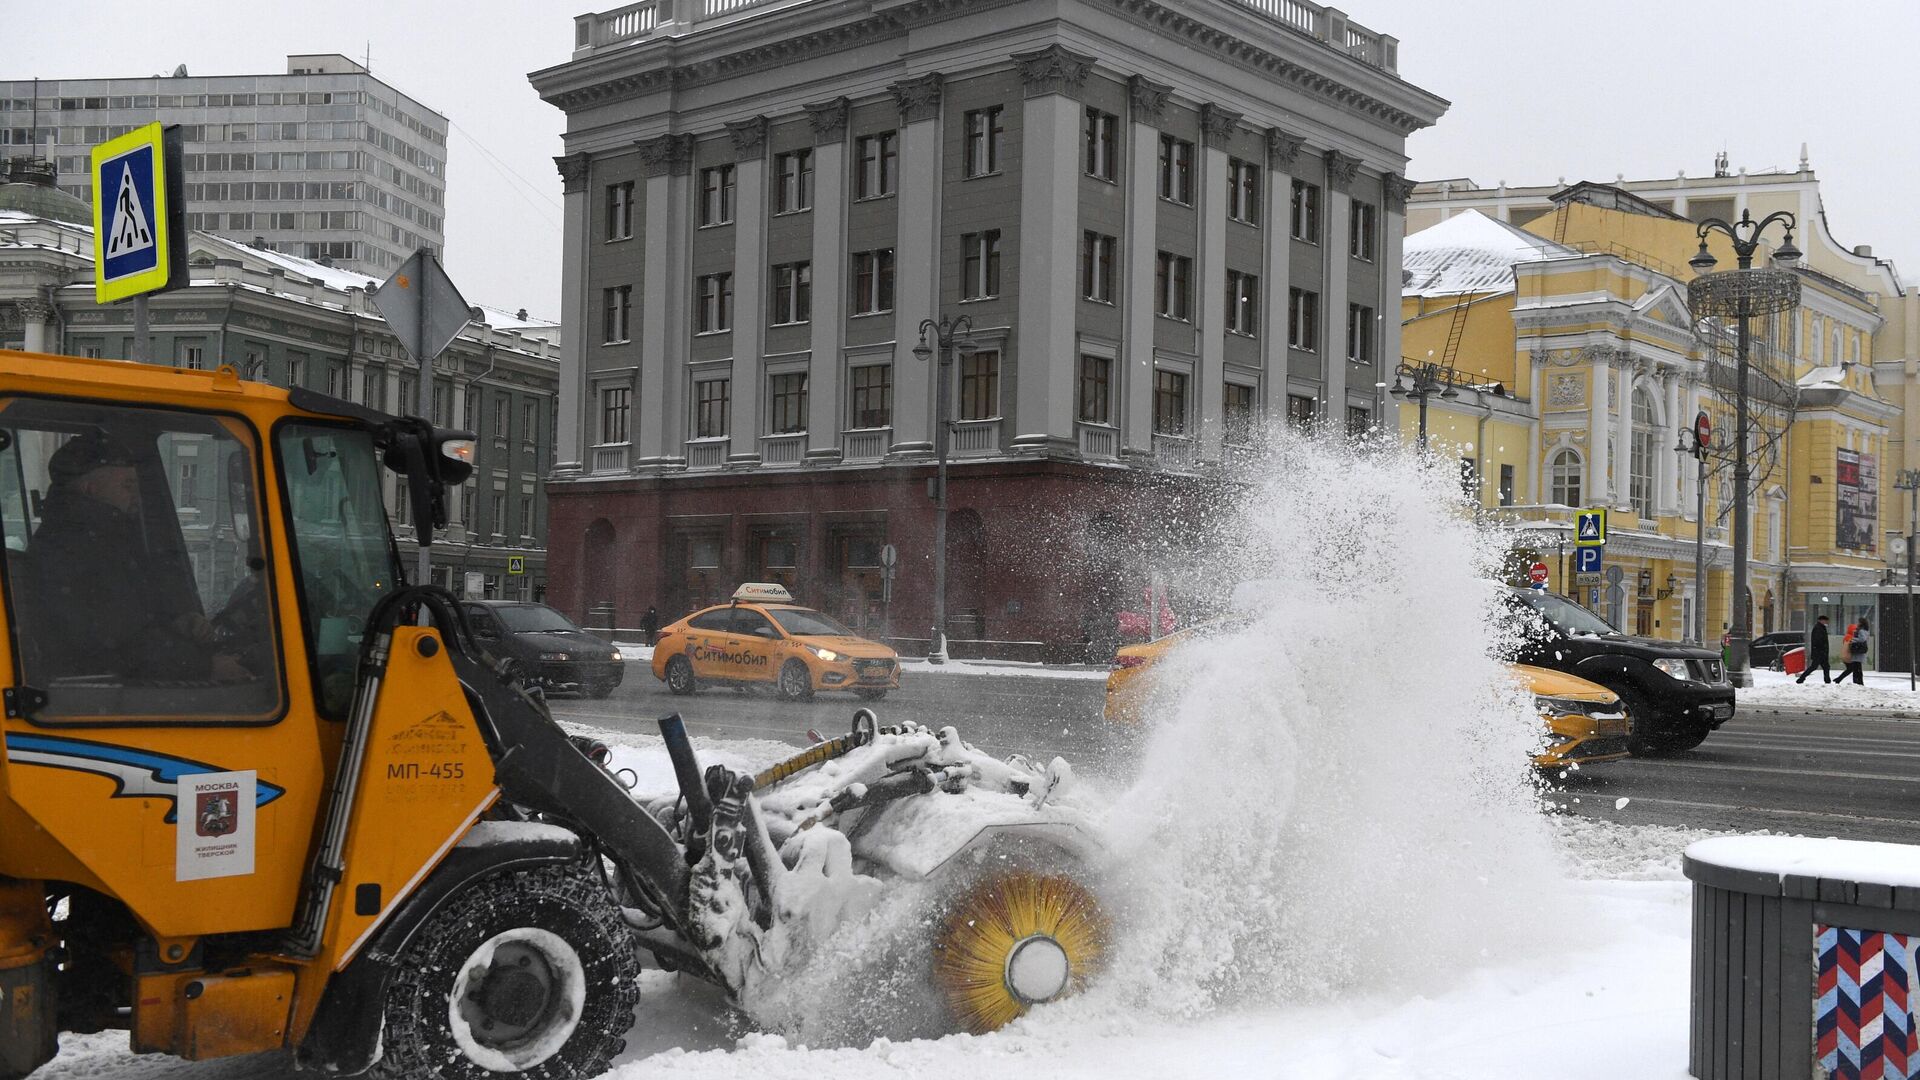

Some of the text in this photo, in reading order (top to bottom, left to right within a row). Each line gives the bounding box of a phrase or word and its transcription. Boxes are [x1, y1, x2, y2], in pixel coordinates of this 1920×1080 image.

[1582, 549, 1597, 571] P
[745, 586, 787, 596] Ситимобил
[694, 646, 768, 666] Ситимобил
[387, 763, 464, 779] МП-455
[195, 782, 238, 792] МОСКВА
[198, 850, 235, 858] ТВЕРСКОЙ
